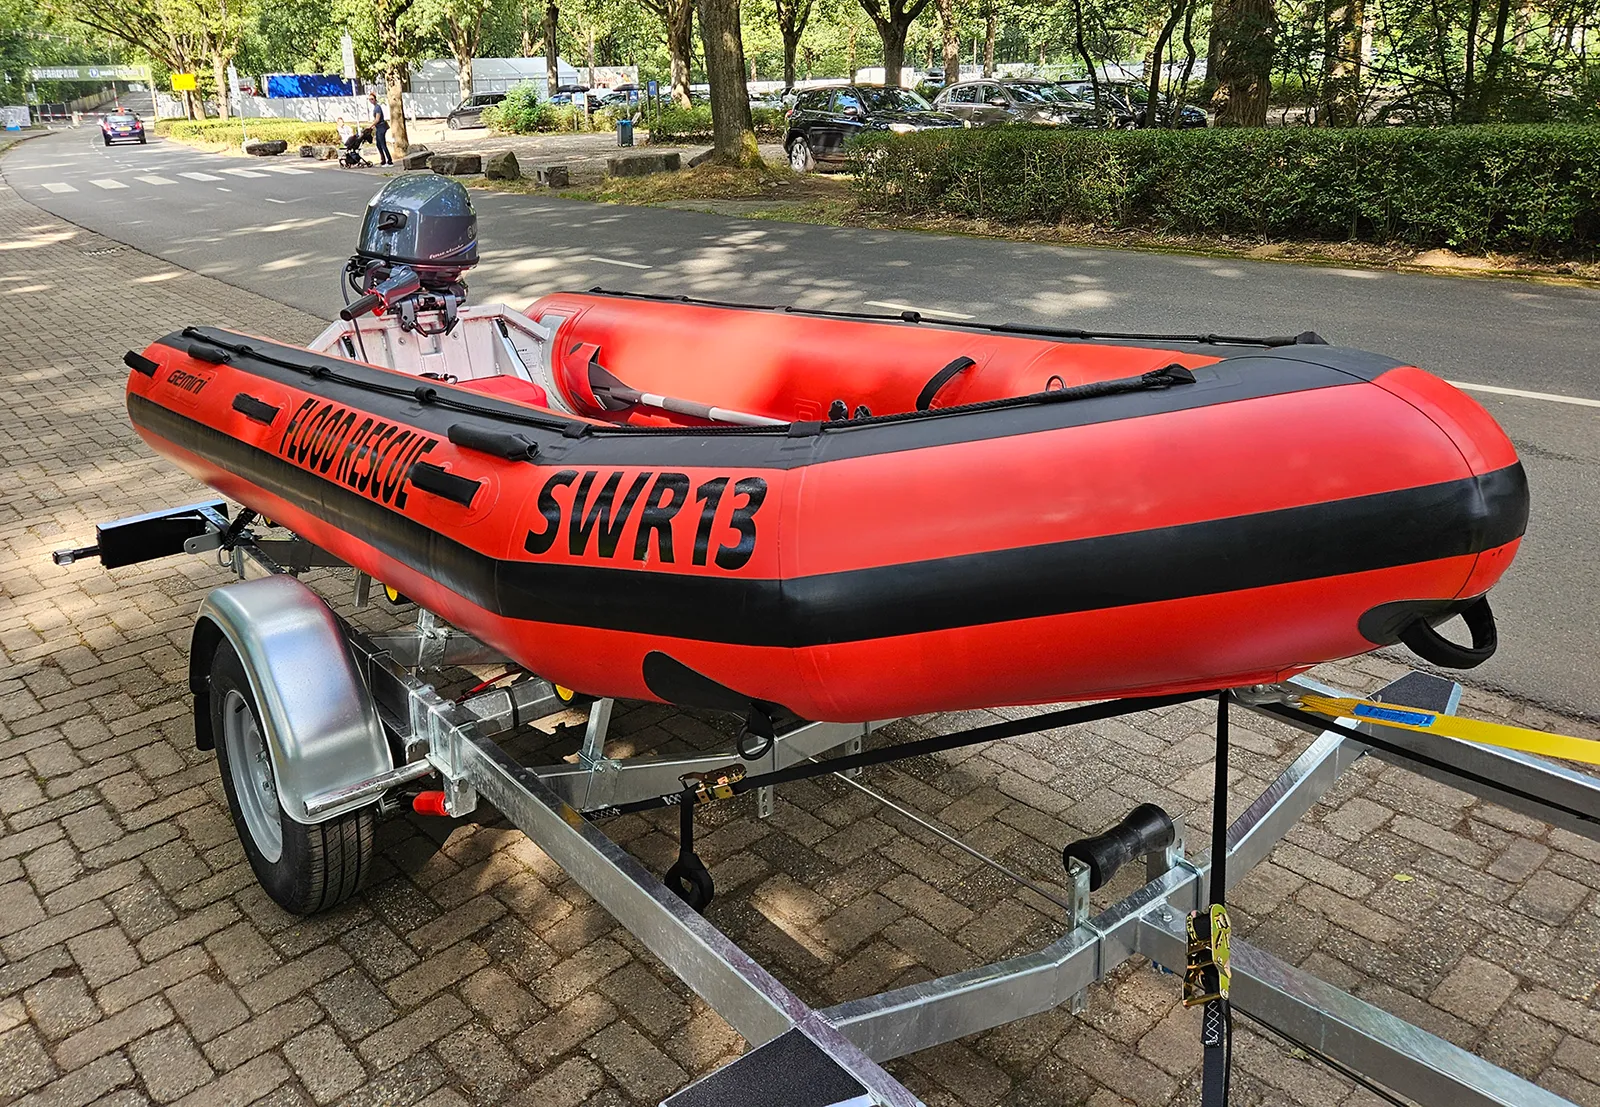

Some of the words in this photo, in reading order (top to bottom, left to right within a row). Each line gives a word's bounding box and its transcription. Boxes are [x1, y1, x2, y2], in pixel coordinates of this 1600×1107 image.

[278, 397, 358, 474] FLOOD
[335, 418, 439, 510] RESCUE
[524, 469, 768, 571] SWR13
